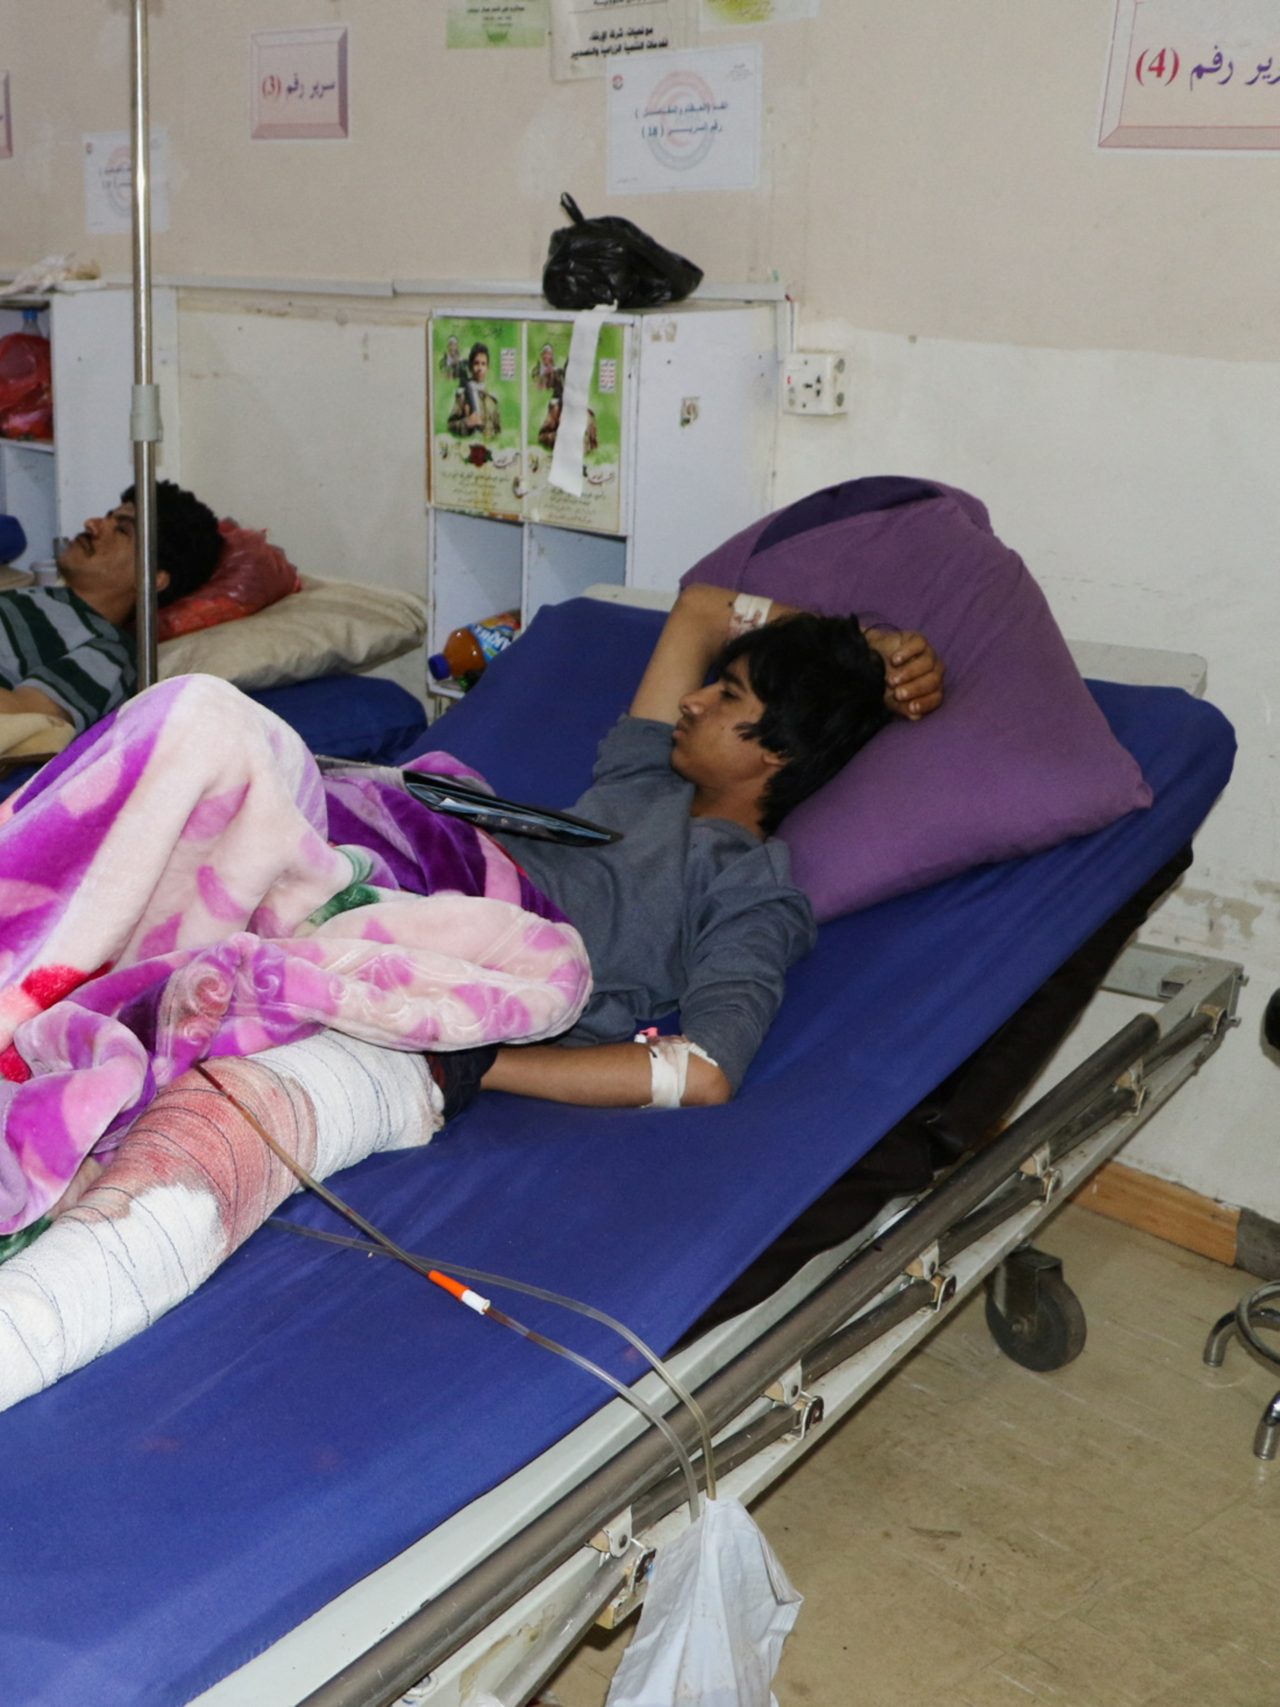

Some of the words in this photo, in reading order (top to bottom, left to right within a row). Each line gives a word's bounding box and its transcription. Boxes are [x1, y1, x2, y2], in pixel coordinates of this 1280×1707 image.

[1135, 47, 1180, 87] (4)
[1189, 45, 1234, 91] رقم
[286, 72, 305, 100] رقم
[309, 81, 336, 99] سرير
